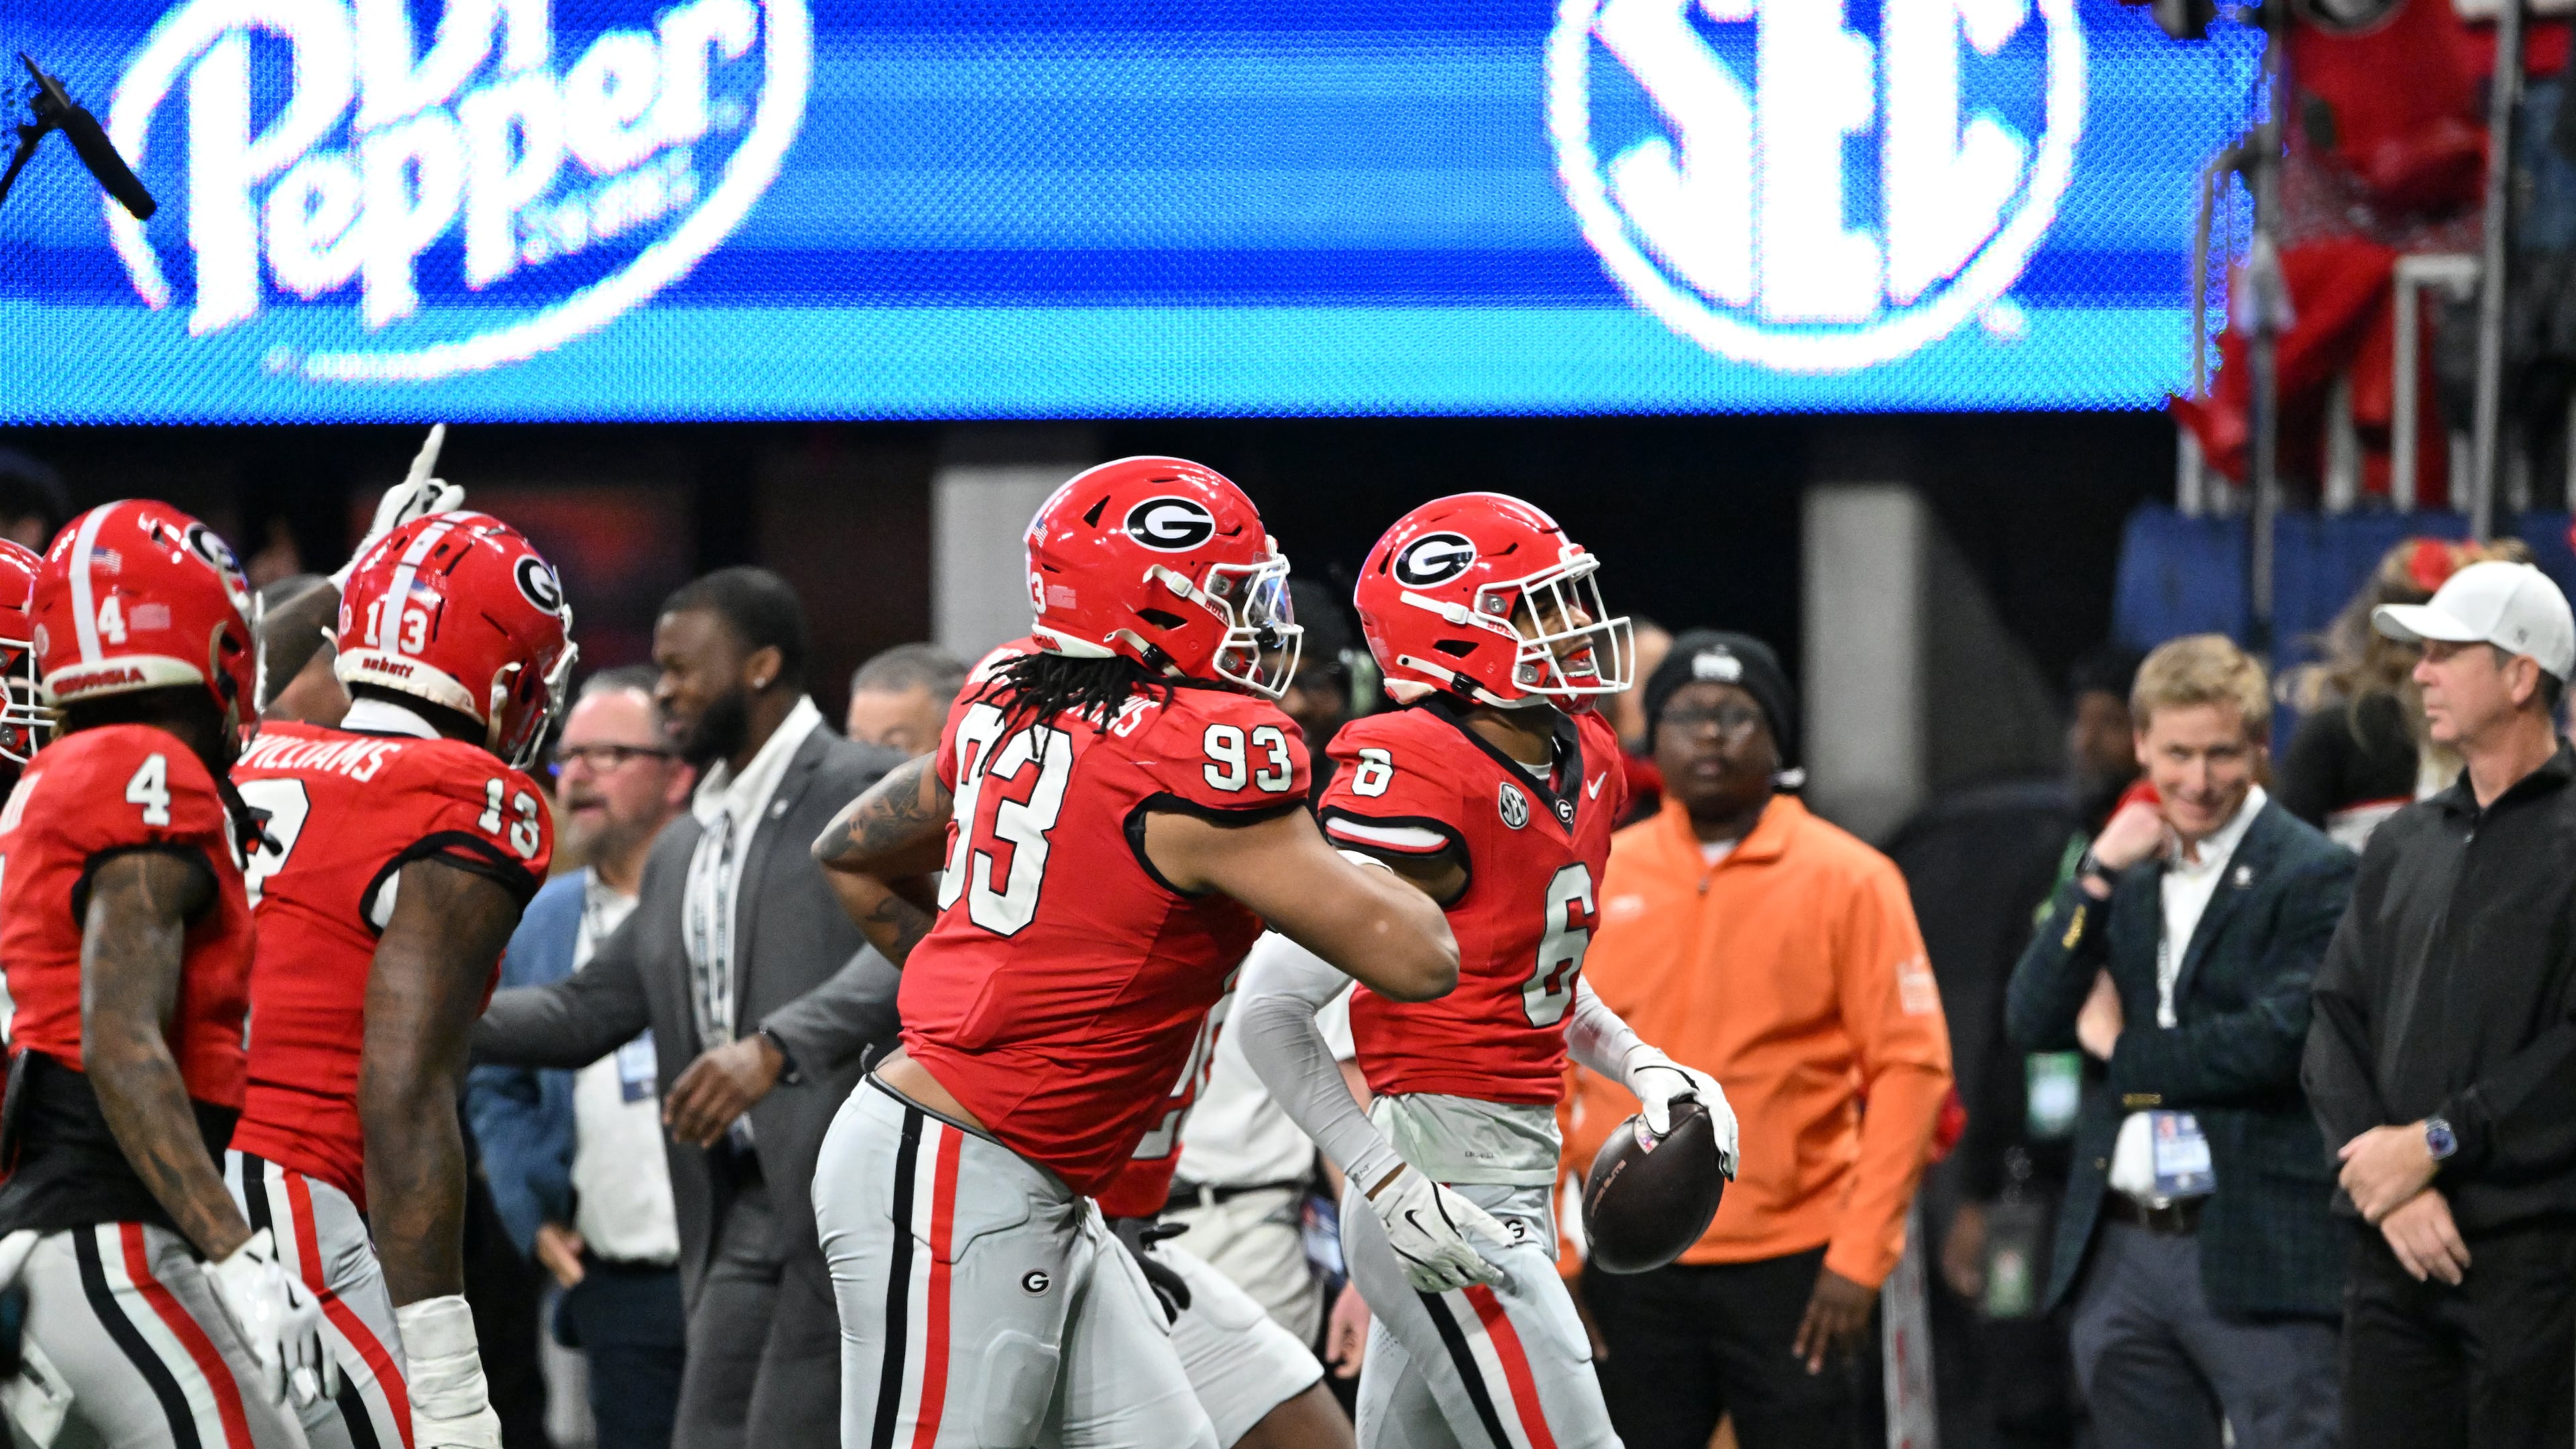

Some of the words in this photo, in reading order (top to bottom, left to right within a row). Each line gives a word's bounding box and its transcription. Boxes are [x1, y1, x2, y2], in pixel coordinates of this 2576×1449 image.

[109, 0, 763, 335] Pepper
[1595, 0, 2033, 323] SEC
[1127, 498, 1212, 549] G
[517, 558, 560, 612] G
[1395, 534, 1473, 586] G
[98, 596, 127, 644] 4
[125, 752, 171, 826] 4
[1203, 723, 1293, 793] 93
[478, 777, 541, 860] 13
[936, 700, 1074, 938] 93
[1521, 861, 1595, 1029] 6
[1022, 1271, 1049, 1293] G
